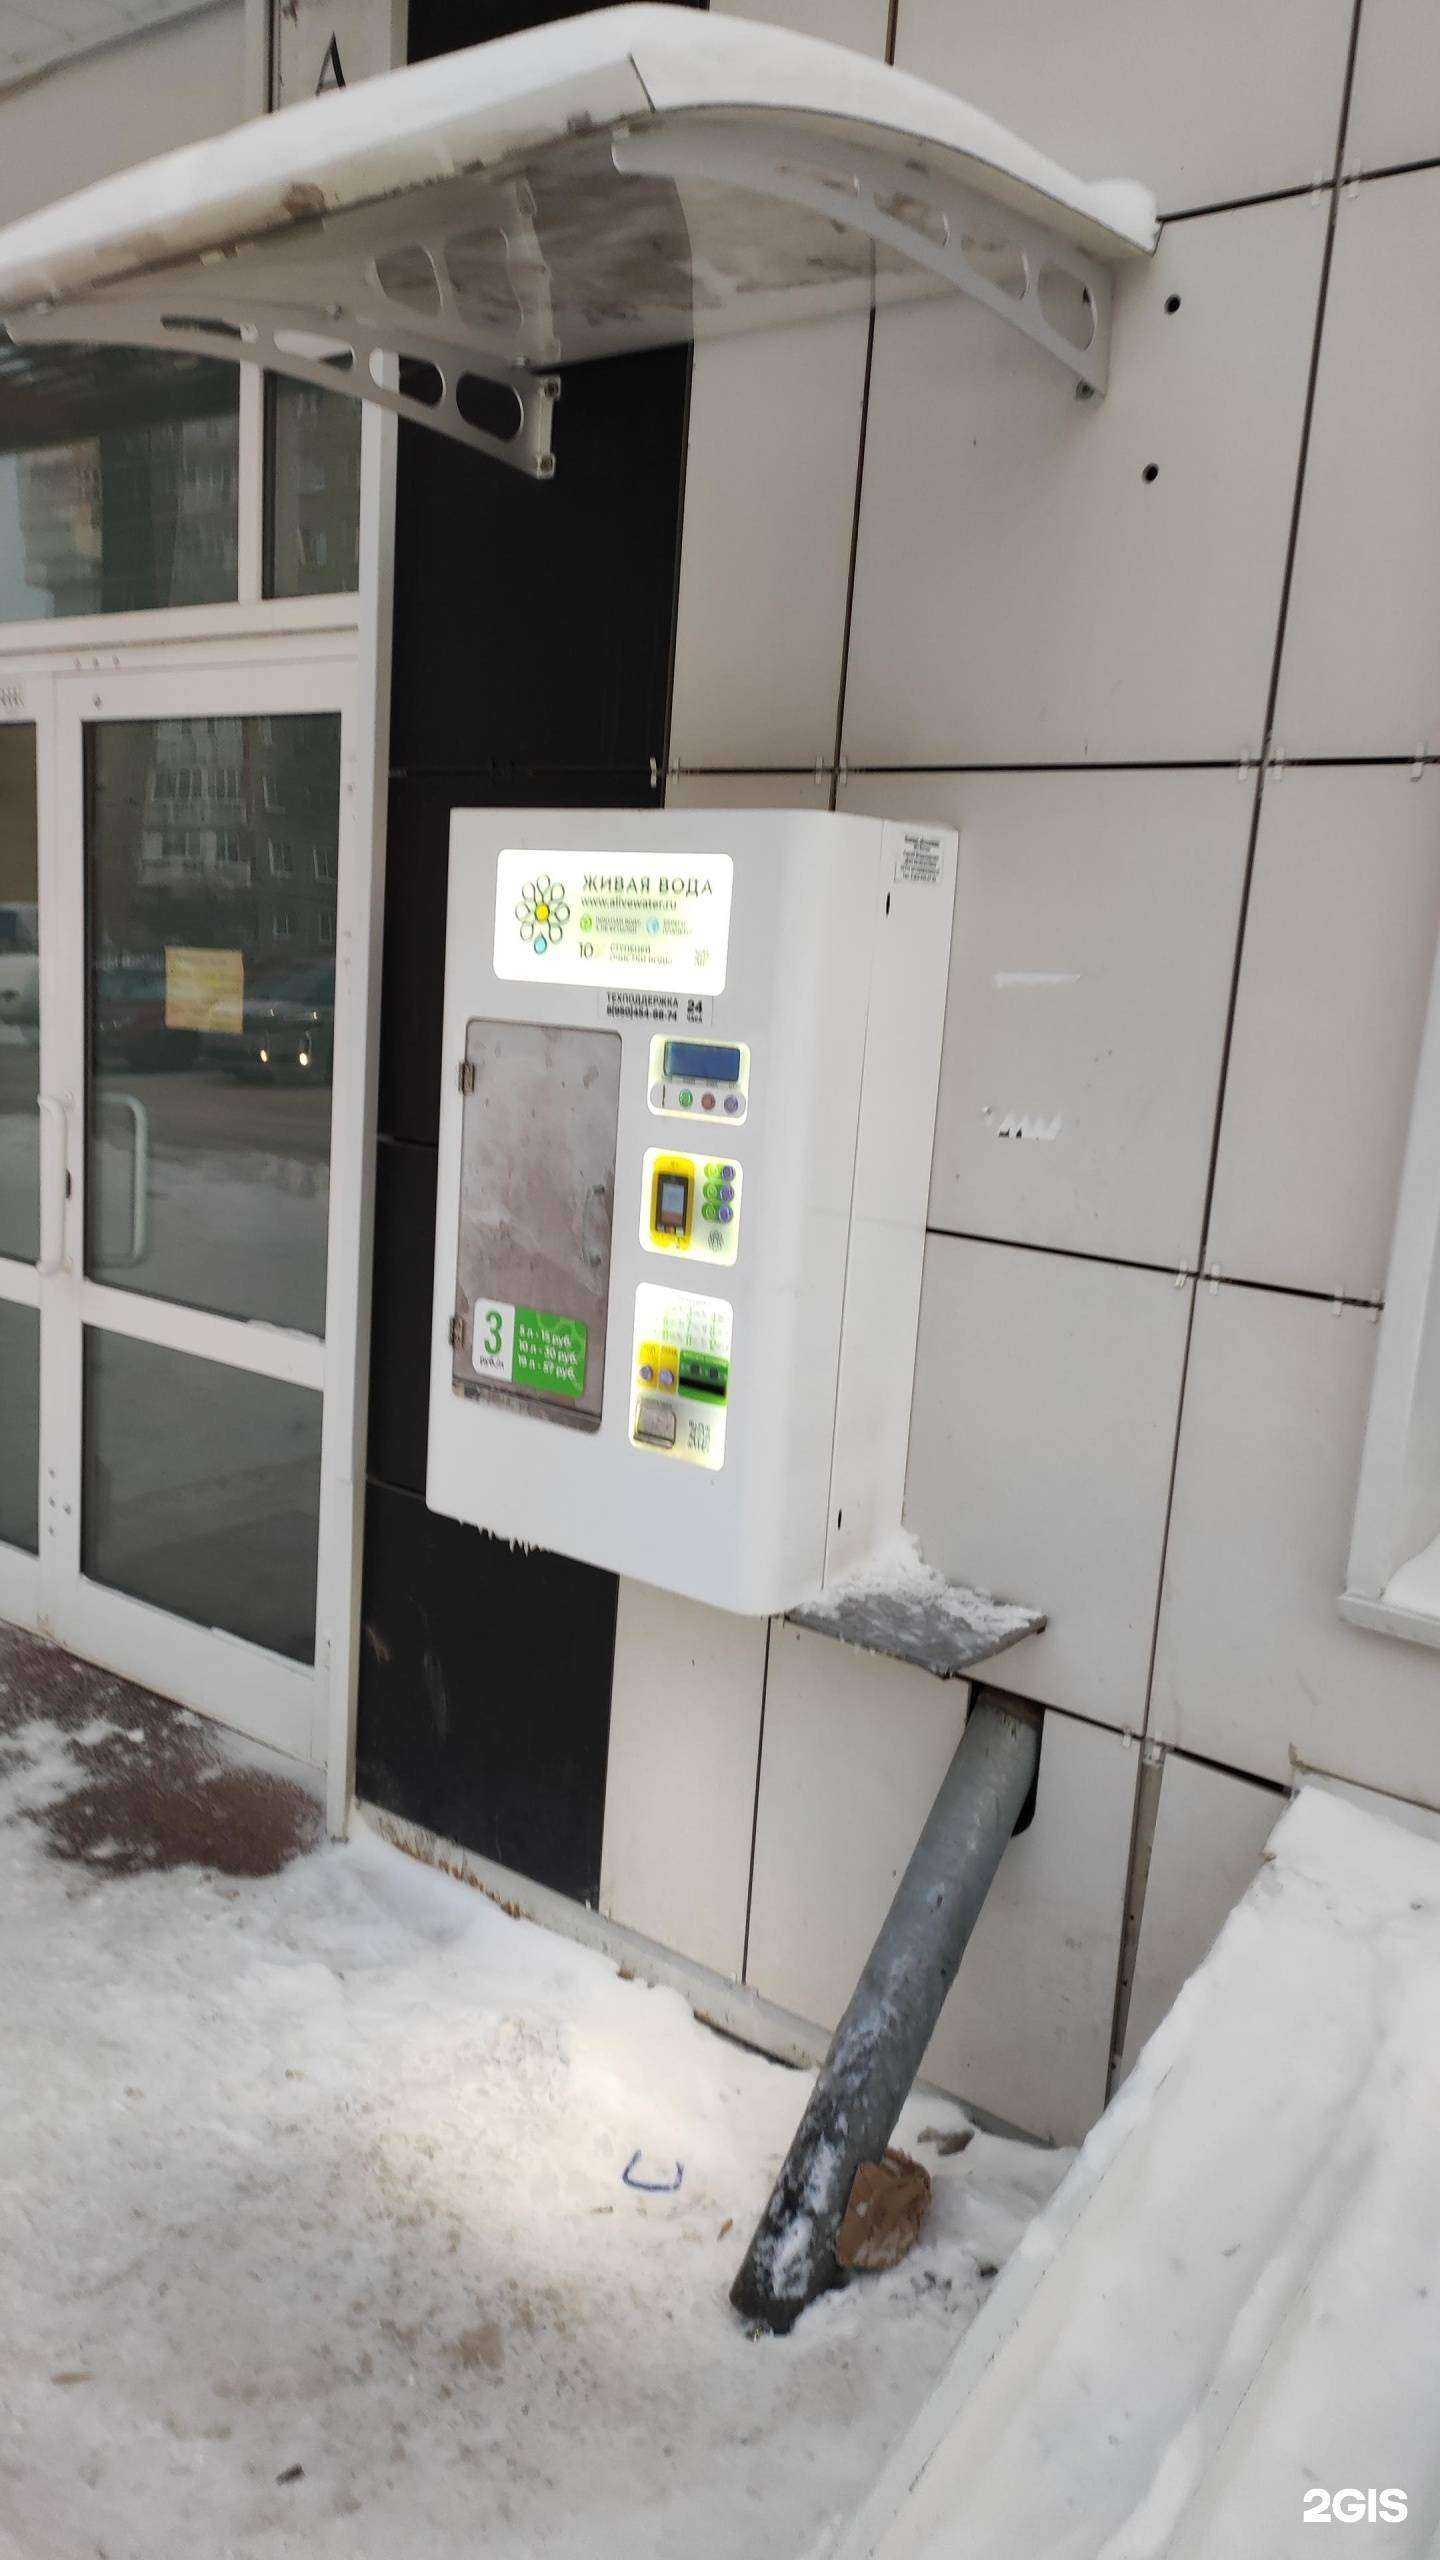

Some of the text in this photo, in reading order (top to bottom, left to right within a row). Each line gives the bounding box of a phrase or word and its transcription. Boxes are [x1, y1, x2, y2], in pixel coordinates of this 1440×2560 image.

[583, 874, 713, 898] ЖИВАЯ ВОДА
[606, 991, 679, 1009] ТЕХПОДДЕРЖКА
[687, 998, 703, 1013] 24
[484, 1311, 503, 1355] 3
[519, 1338, 529, 1354] 10
